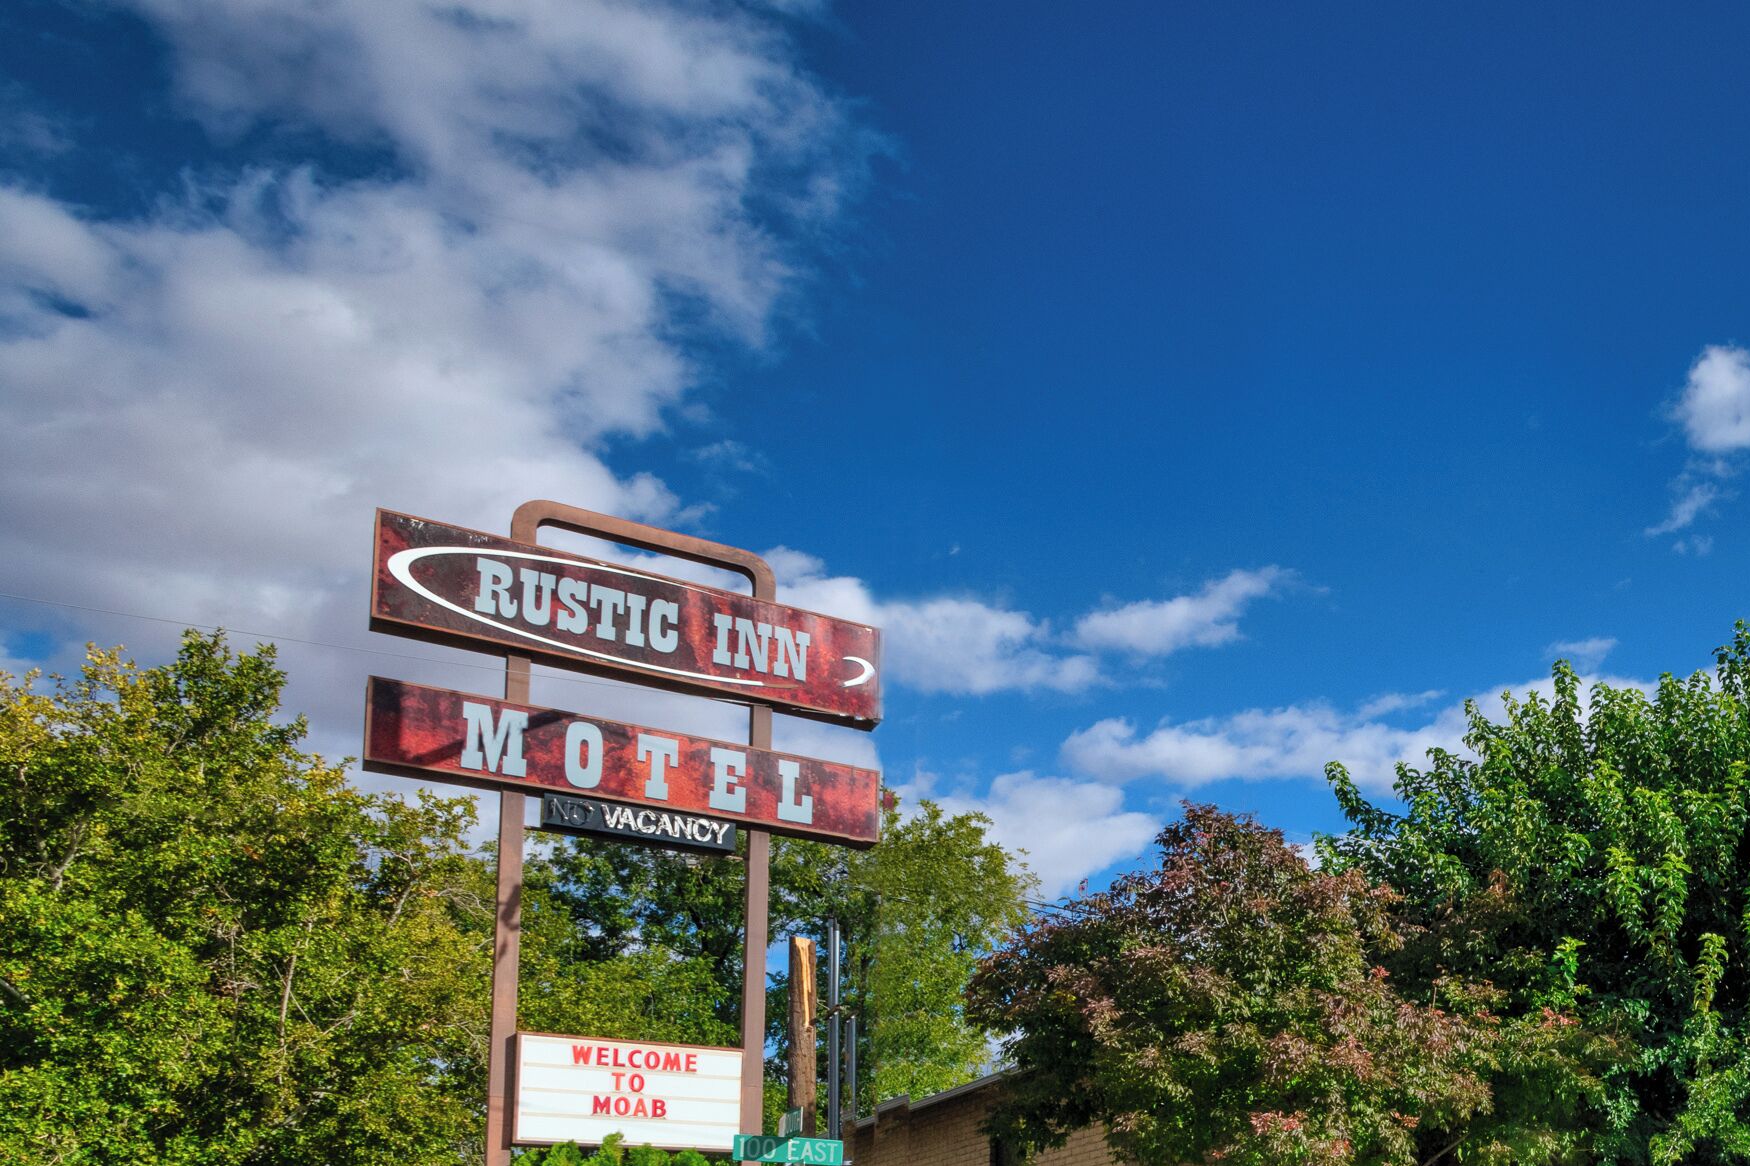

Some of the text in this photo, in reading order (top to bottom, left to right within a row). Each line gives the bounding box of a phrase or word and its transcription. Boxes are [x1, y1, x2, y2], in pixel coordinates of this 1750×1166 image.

[475, 557, 810, 682] RUSTIC INN
[460, 701, 813, 824] MOTEL
[550, 798, 730, 844] NO VACANCY
[572, 1045, 697, 1072] WELCOME
[612, 1072, 645, 1092] TO
[592, 1095, 667, 1118] MOAB
[739, 1137, 838, 1163] 100 EAST
